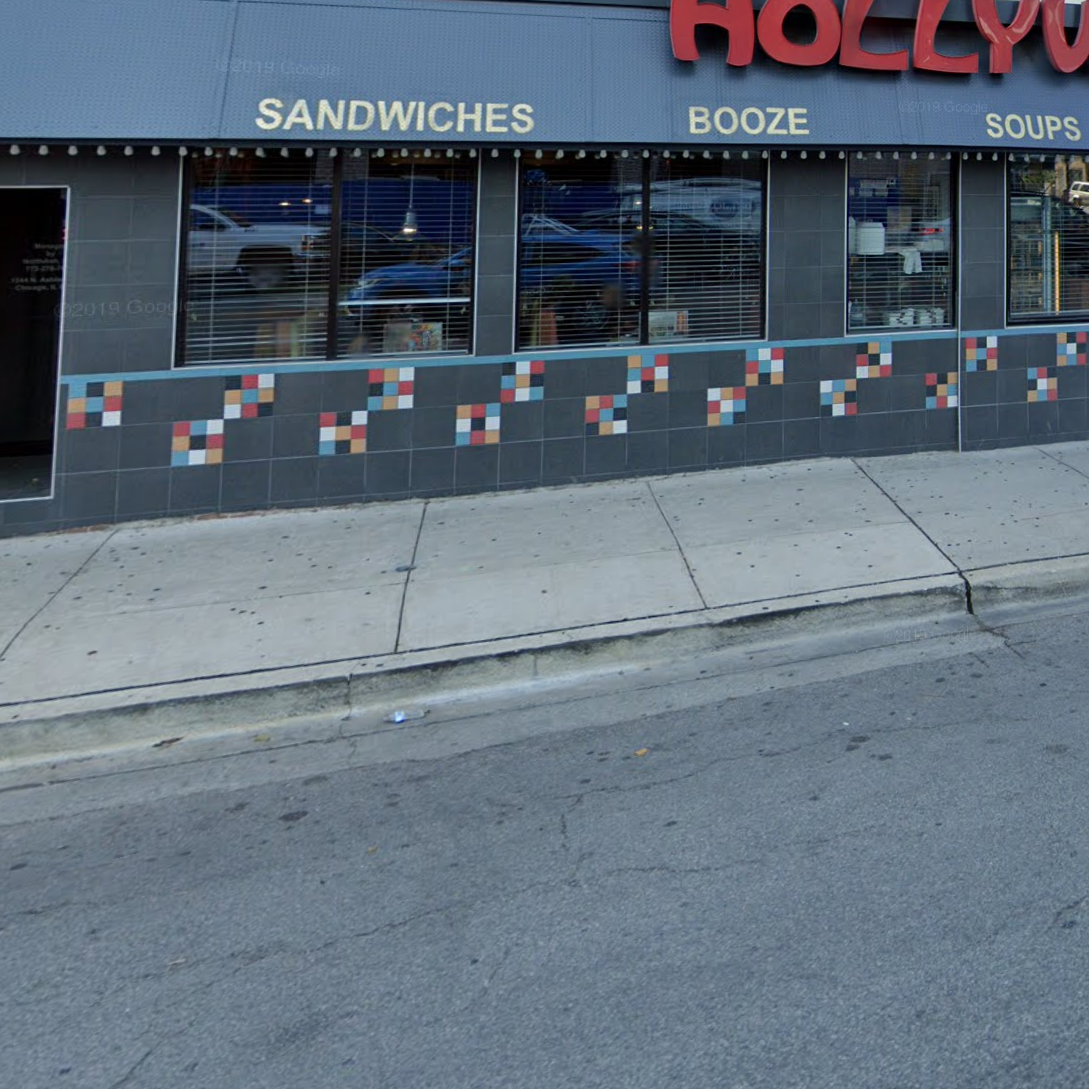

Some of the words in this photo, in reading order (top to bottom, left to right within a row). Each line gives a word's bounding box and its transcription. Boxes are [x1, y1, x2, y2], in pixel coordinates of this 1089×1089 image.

[255, 98, 536, 134] SANDWICHES
[688, 106, 810, 136] BOOZE
[986, 112, 1082, 141] SOUPS
